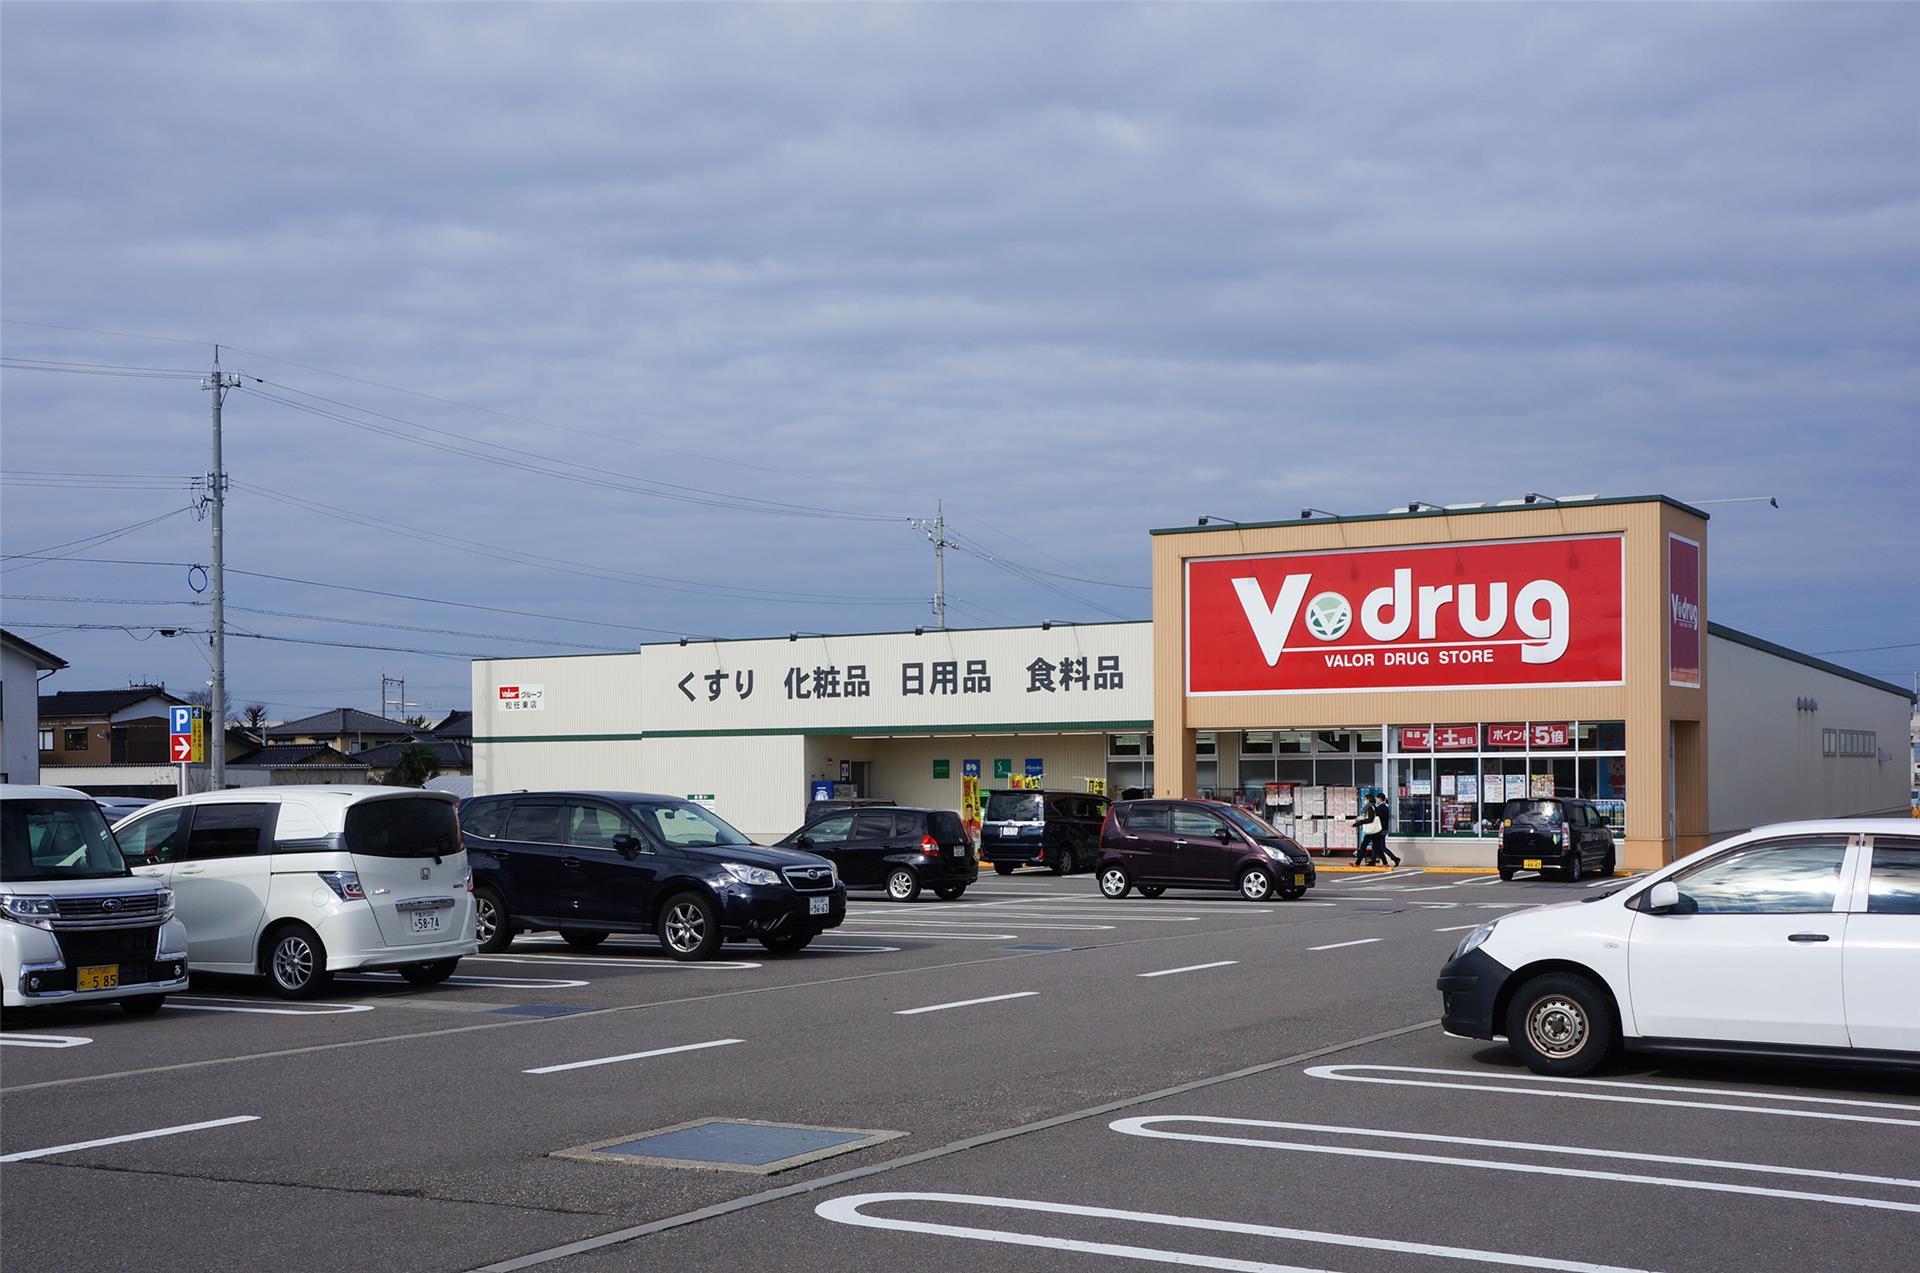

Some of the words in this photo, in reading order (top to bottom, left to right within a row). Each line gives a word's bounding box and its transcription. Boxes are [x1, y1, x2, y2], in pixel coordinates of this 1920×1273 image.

[1325, 653, 1375, 668] VALOR
[1384, 651, 1430, 666] DRUG
[1439, 649, 1495, 665] STORE
[678, 669, 754, 702] くすり
[784, 665, 871, 700] 化粧品
[902, 660, 991, 696] 日用品
[1026, 656, 1124, 693] 食料品
[176, 709, 188, 731] P
